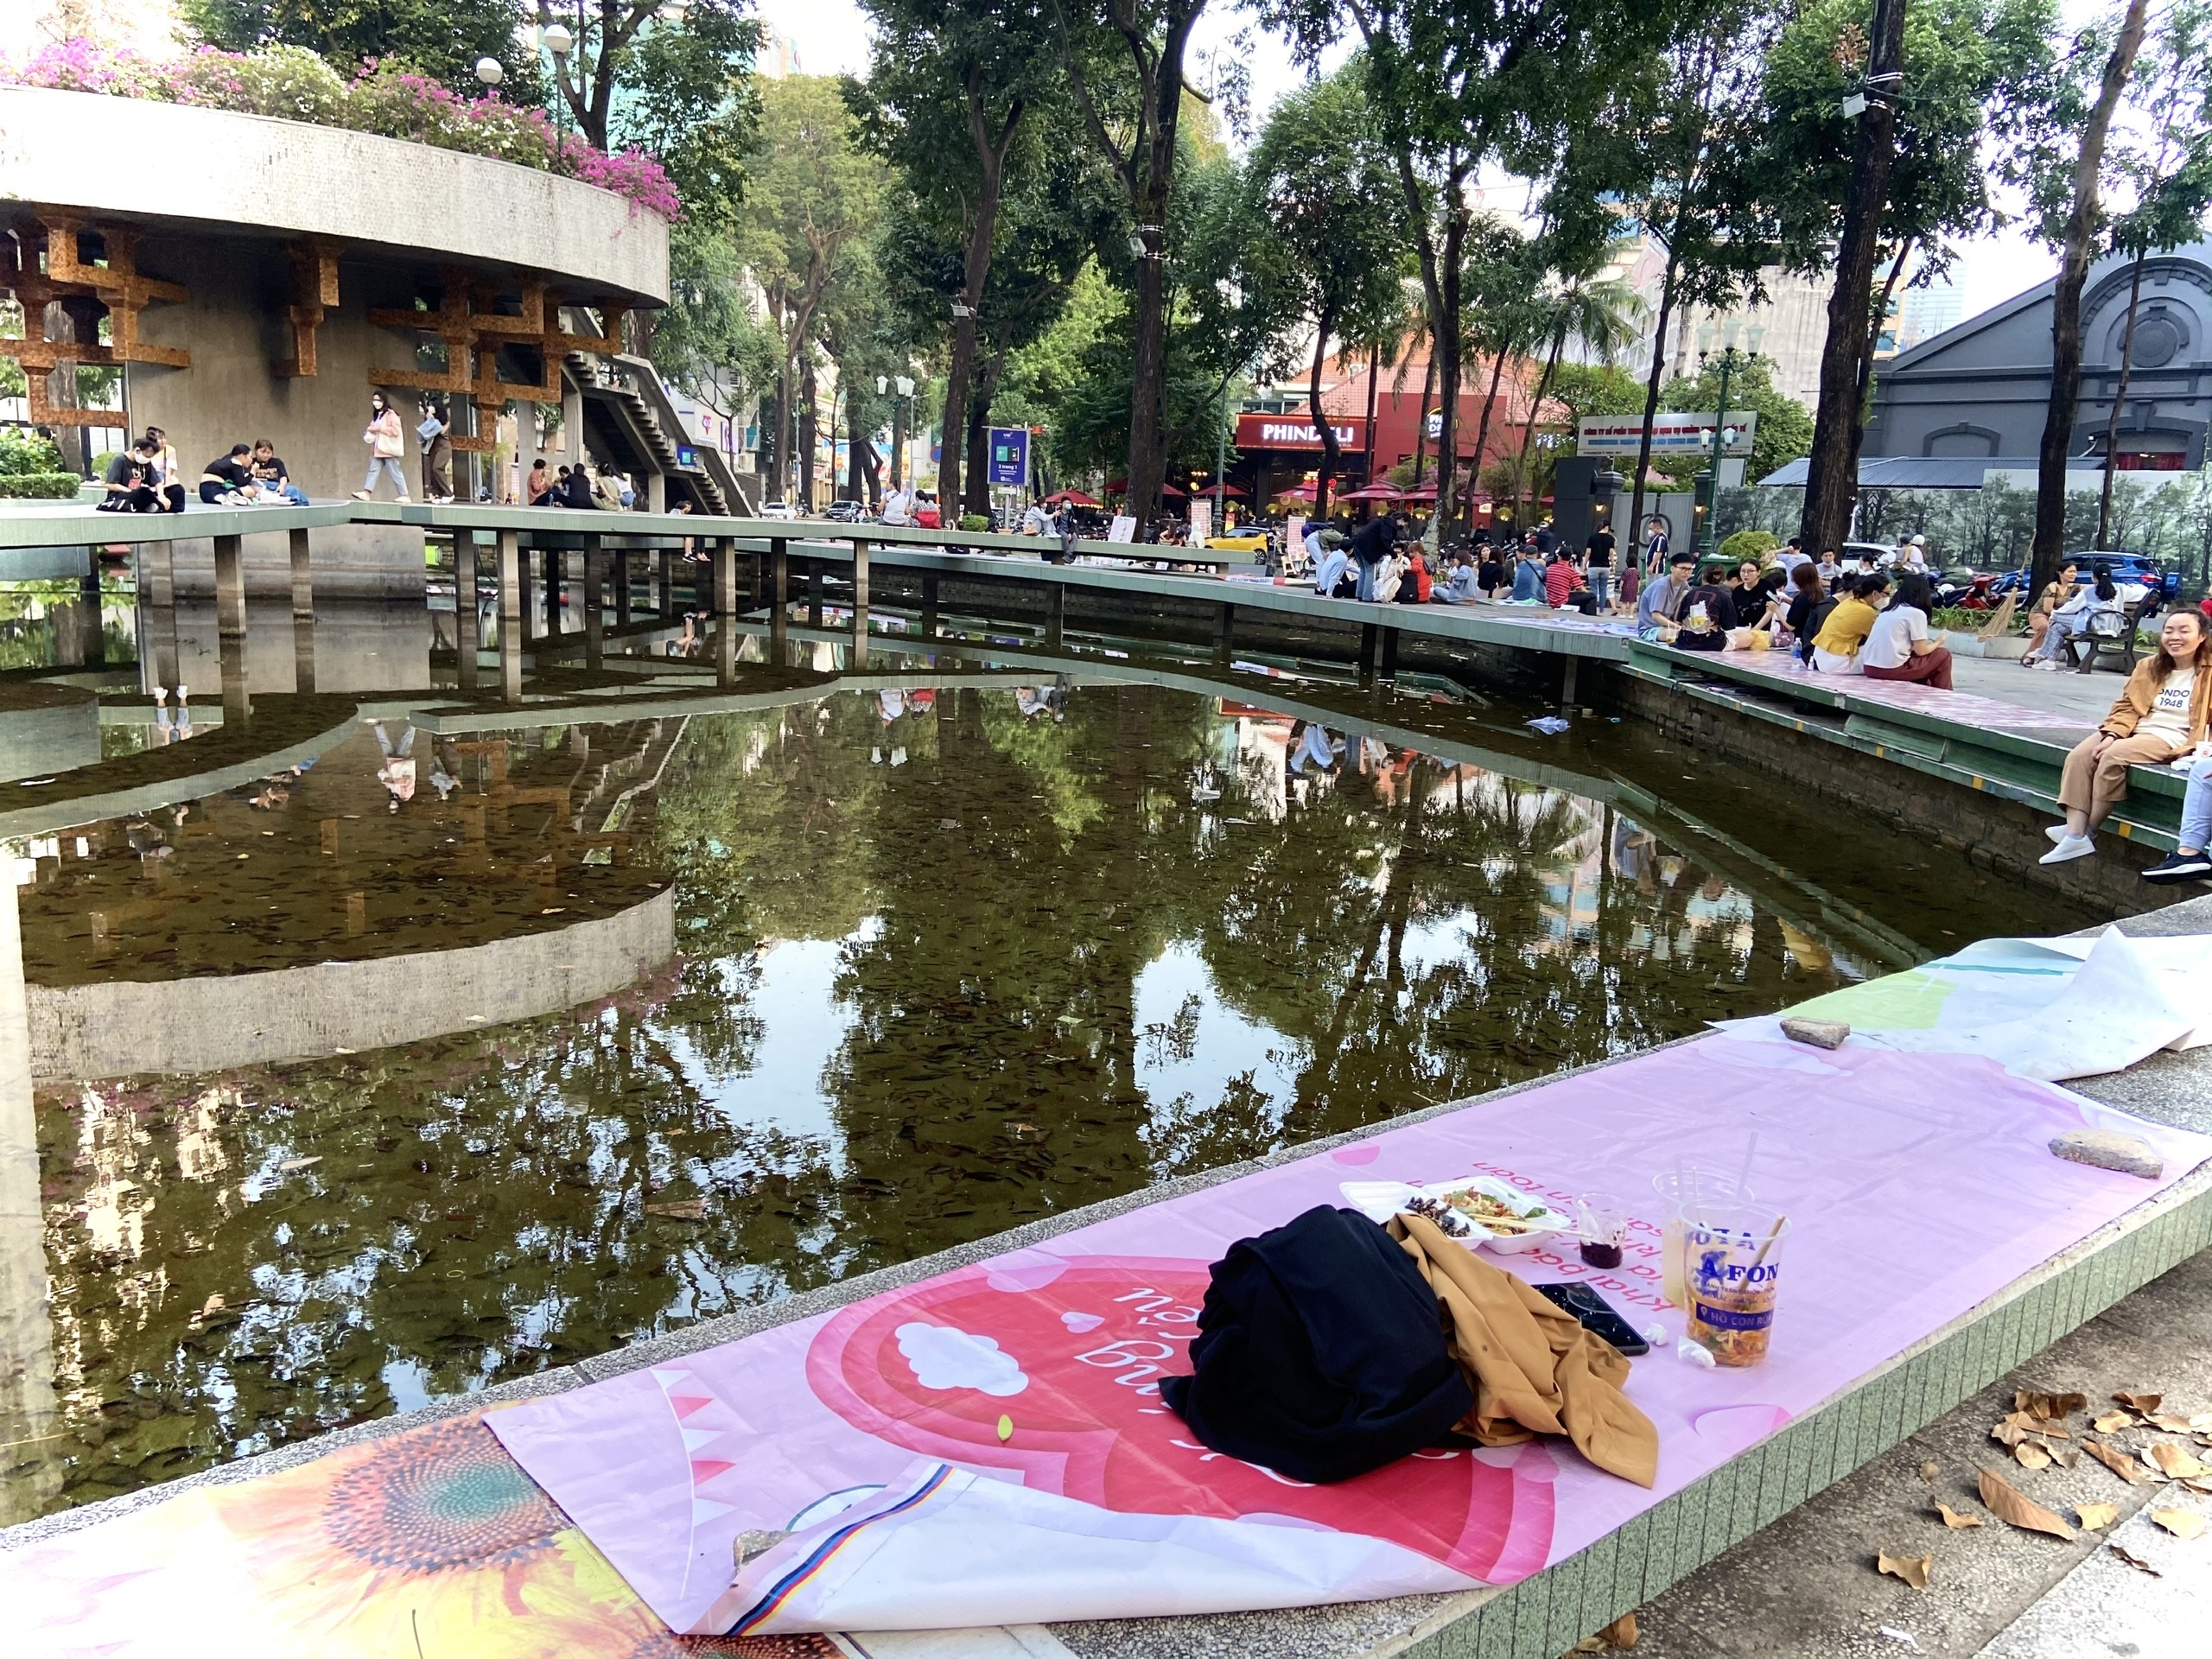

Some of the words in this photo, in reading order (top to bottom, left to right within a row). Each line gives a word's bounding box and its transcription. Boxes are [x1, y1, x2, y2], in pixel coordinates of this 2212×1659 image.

[1262, 423, 1354, 442] PHINDLI
[2158, 689, 2190, 697] ONDO
[2160, 697, 2183, 708] 1948
[1731, 1317, 1755, 1326] CON
